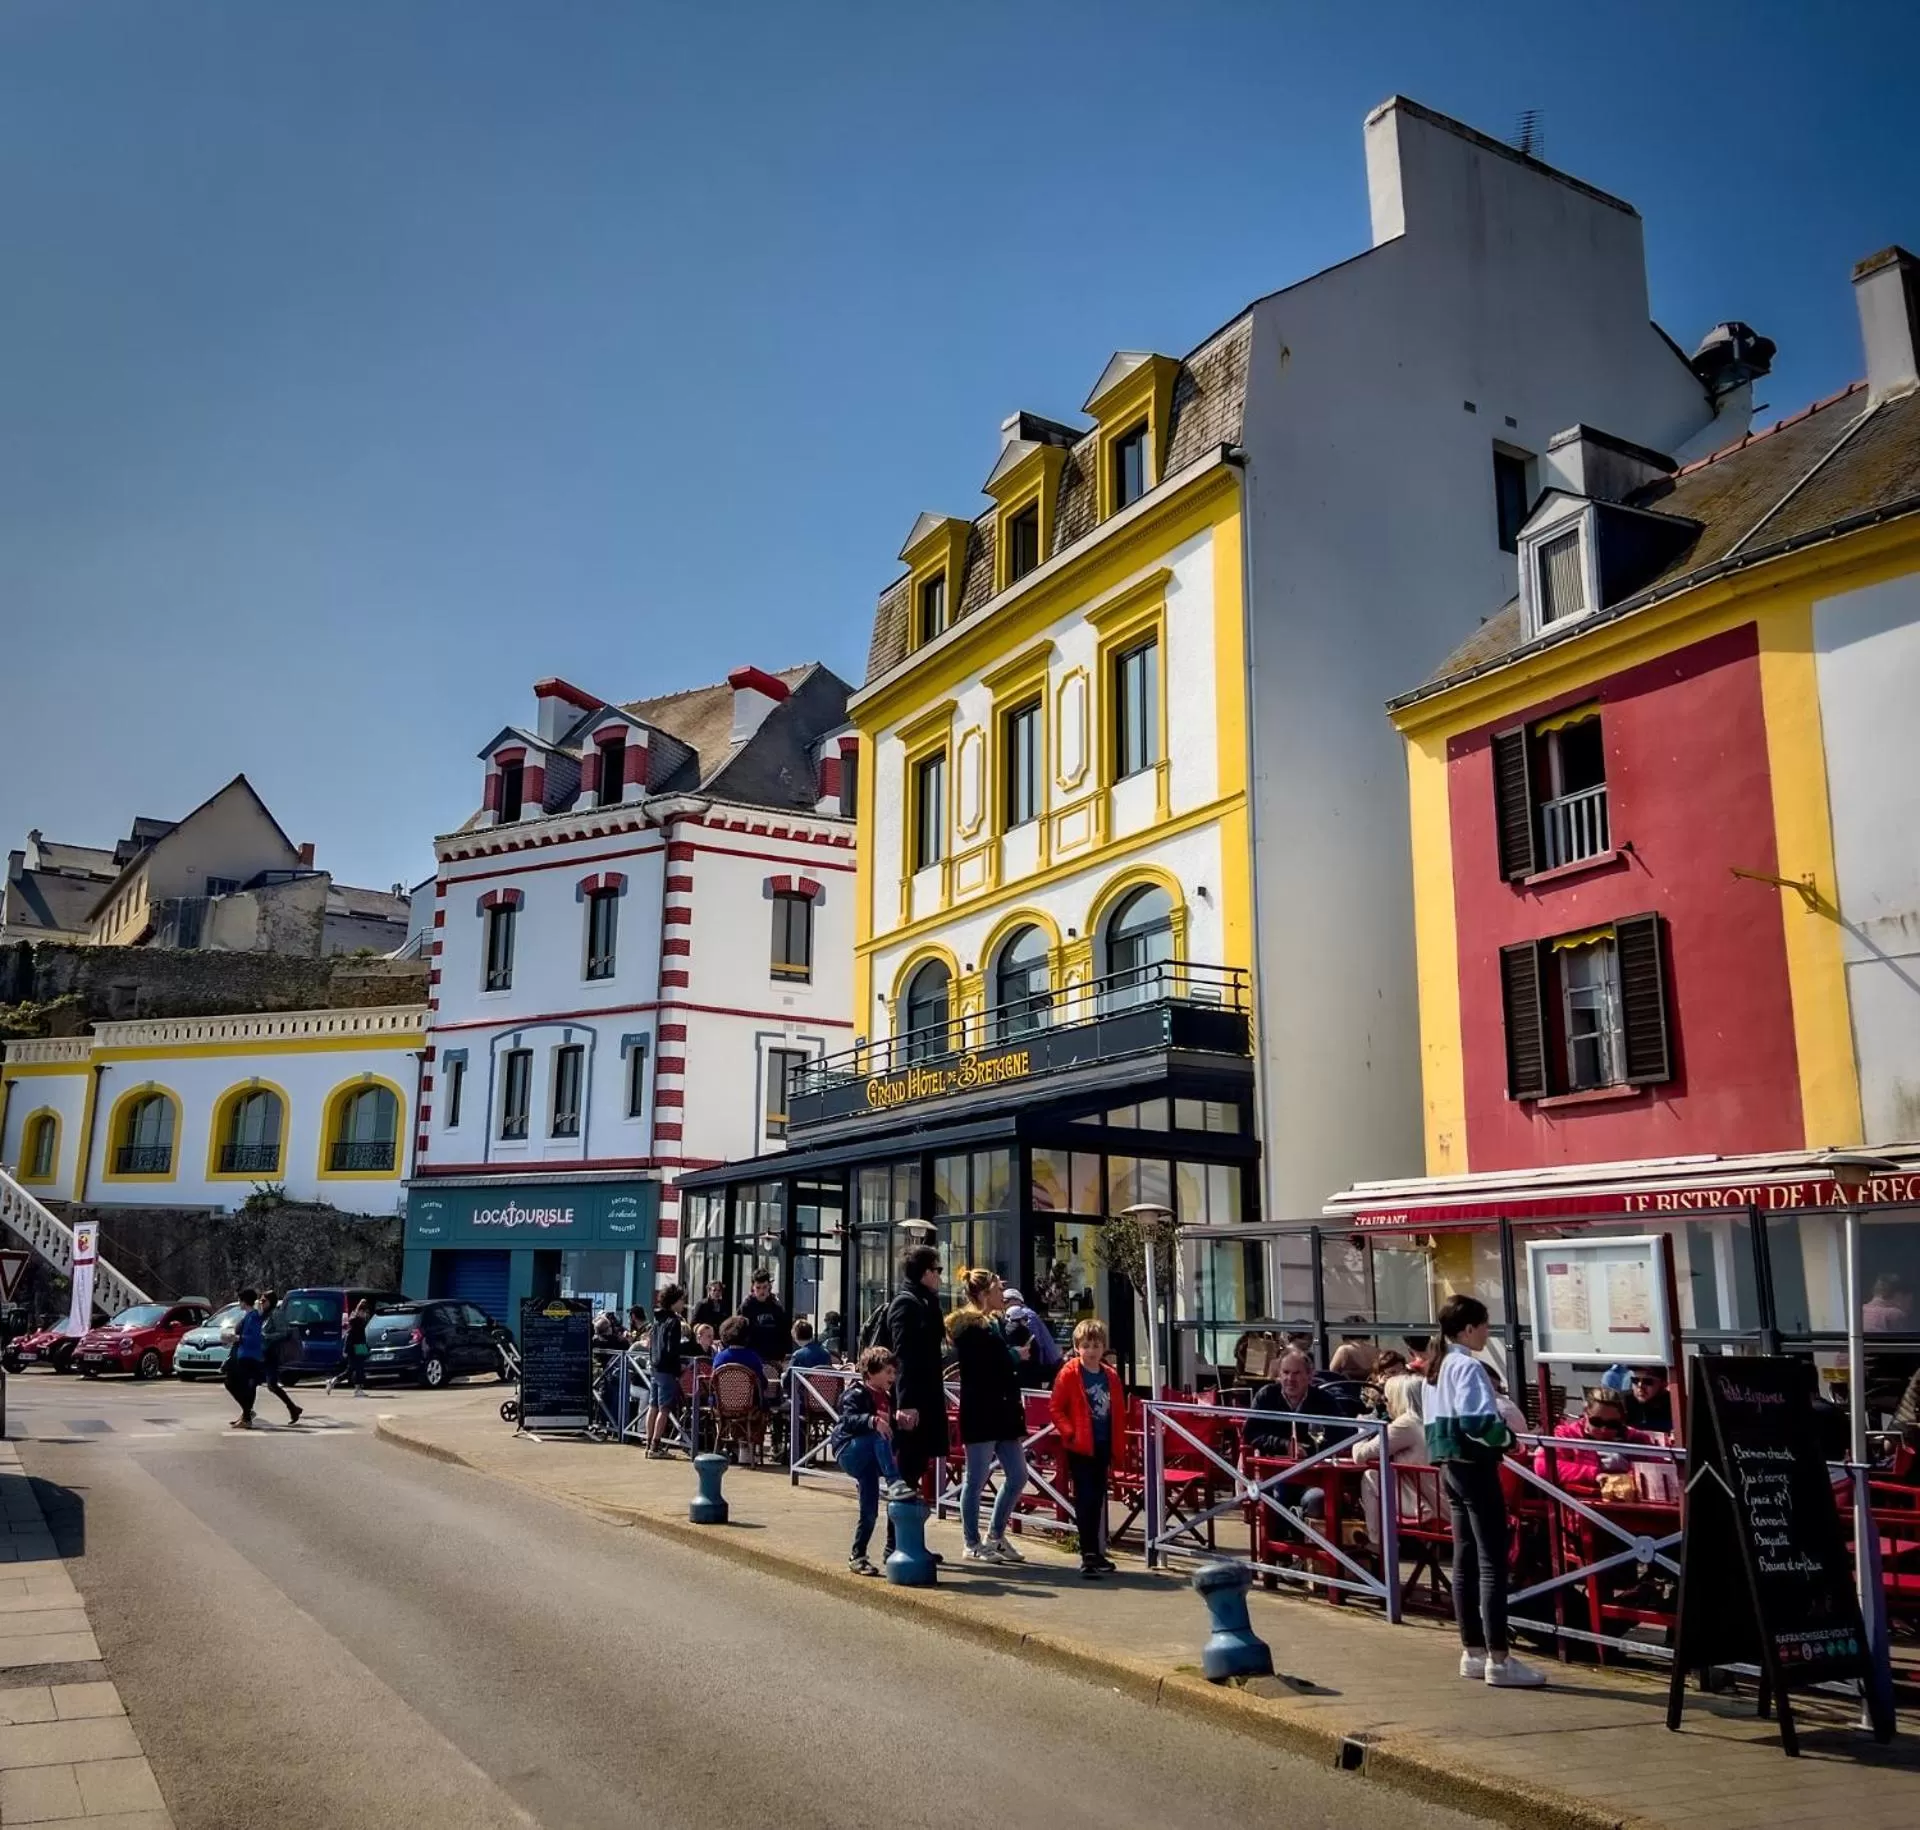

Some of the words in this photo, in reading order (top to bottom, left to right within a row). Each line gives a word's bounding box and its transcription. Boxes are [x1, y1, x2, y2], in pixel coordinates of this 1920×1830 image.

[1655, 1186, 1761, 1211] BISTROT
[1768, 1184, 1806, 1209] DE
[1812, 1183, 1848, 1206] LA
[473, 1201, 574, 1227] LOCATOURISLE
